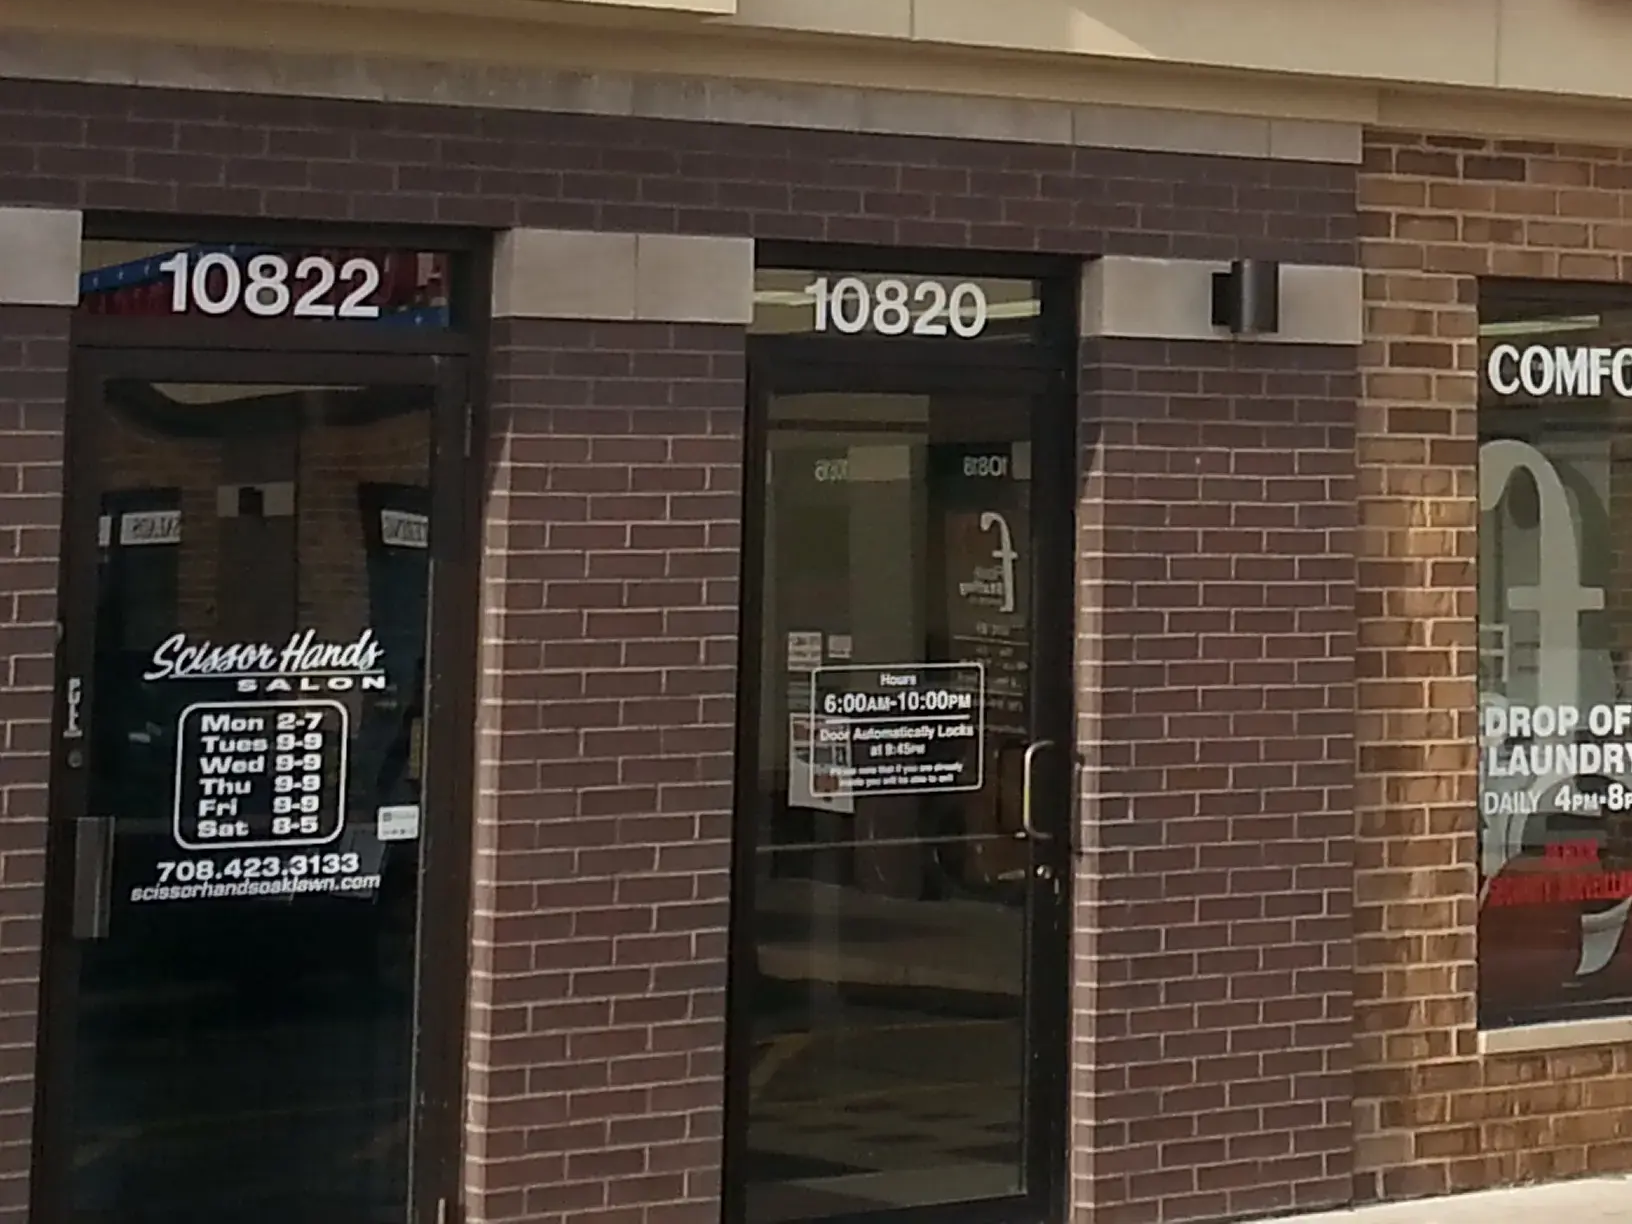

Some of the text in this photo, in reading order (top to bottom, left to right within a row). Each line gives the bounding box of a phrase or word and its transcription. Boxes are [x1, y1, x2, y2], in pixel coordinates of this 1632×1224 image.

[159, 251, 381, 319] 10822
[804, 276, 988, 339] 10820
[144, 628, 386, 682] Scissor Hands
[237, 677, 387, 693] SALON
[879, 672, 917, 687] Hours
[823, 689, 972, 715] 6:00AM-10:00PM
[201, 712, 323, 733] Mon 2-7
[1485, 705, 1579, 738] DROP
[820, 723, 974, 743] Door Automatically Locks
[201, 734, 323, 754] Tues 9-9
[199, 756, 265, 775] Wed
[199, 777, 252, 796] Thu
[198, 798, 238, 817] Fri
[1484, 790, 1541, 815] DAILY
[197, 819, 249, 838] Sat
[156, 852, 360, 883] 708.423.3133
[130, 873, 381, 902] scissorhandsoaklawn.com
